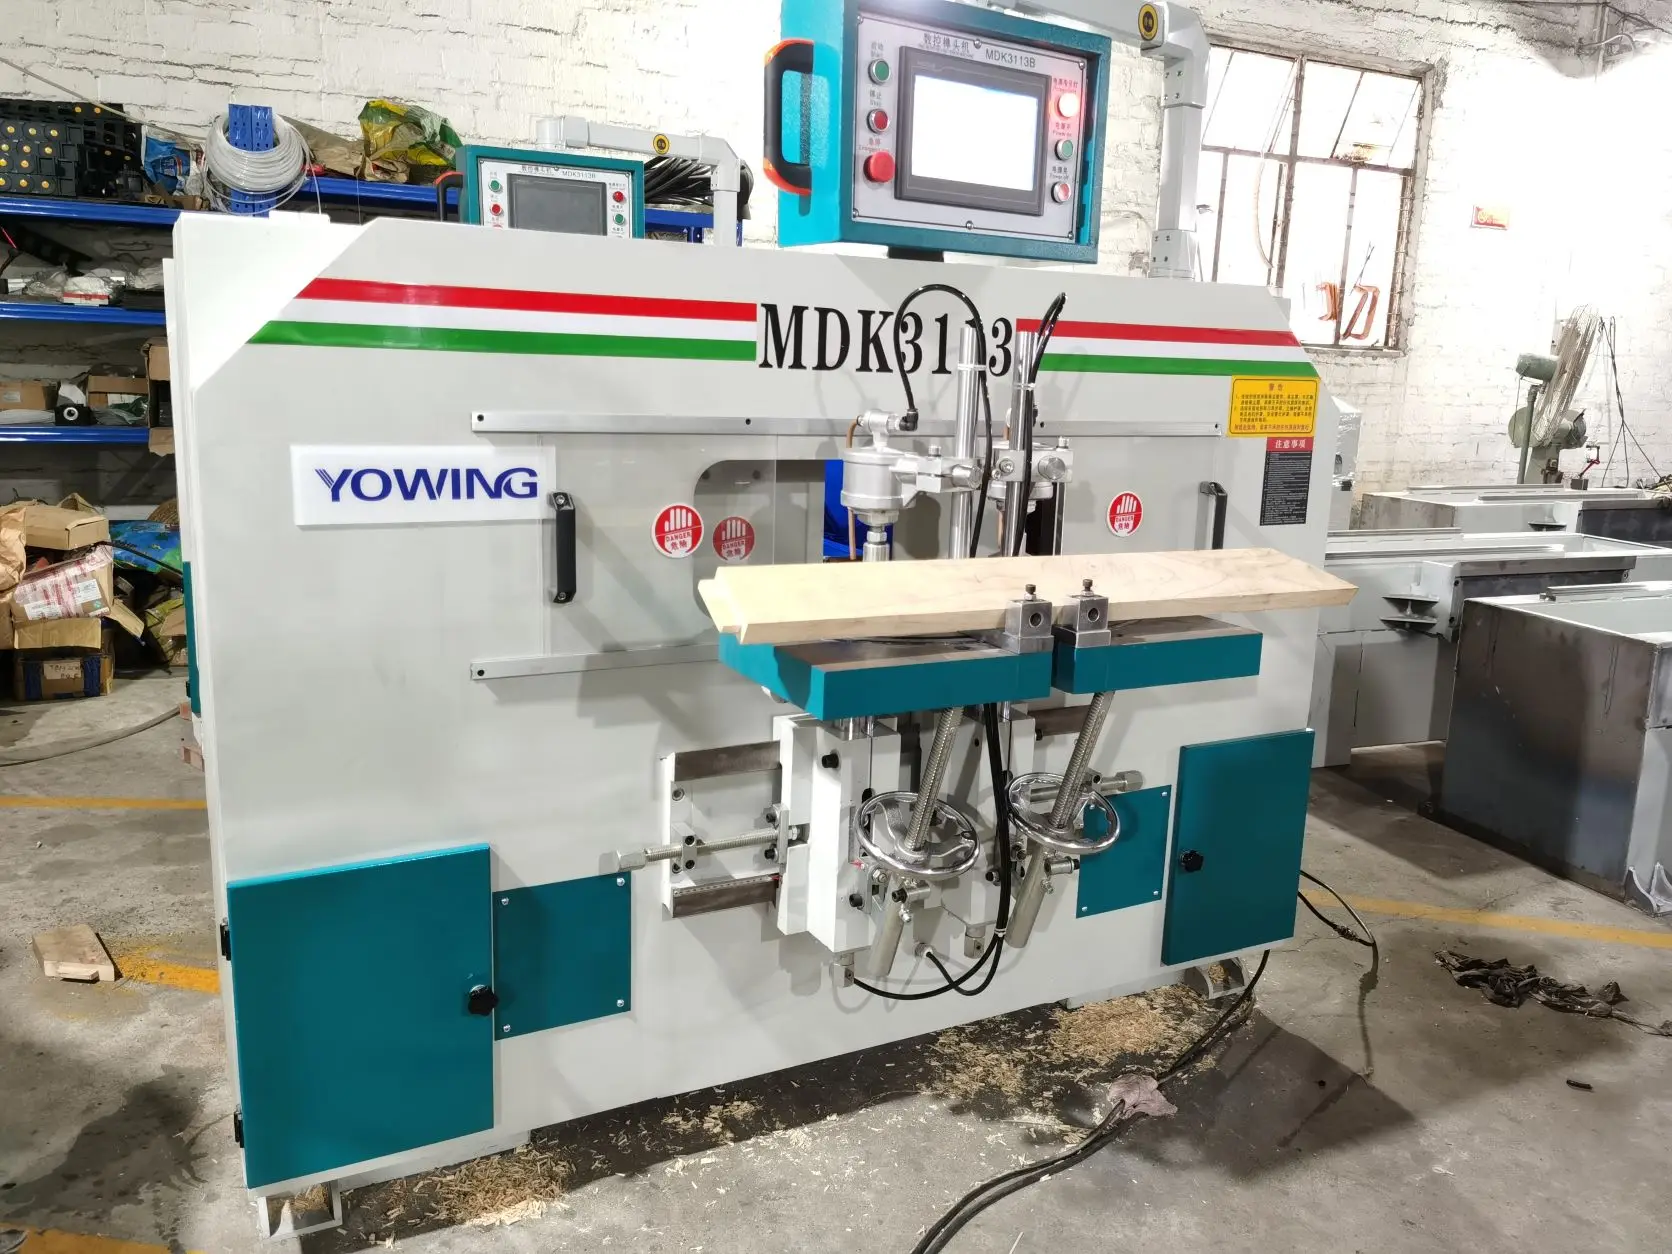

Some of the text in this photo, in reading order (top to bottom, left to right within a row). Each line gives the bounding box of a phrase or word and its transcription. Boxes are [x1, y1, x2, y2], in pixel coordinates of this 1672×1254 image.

[985, 48, 1036, 68] MDK3113B
[758, 303, 1013, 377] MDK313
[314, 467, 538, 502] YOWING
[665, 531, 691, 542] DANGER
[722, 540, 745, 550] DANGER
